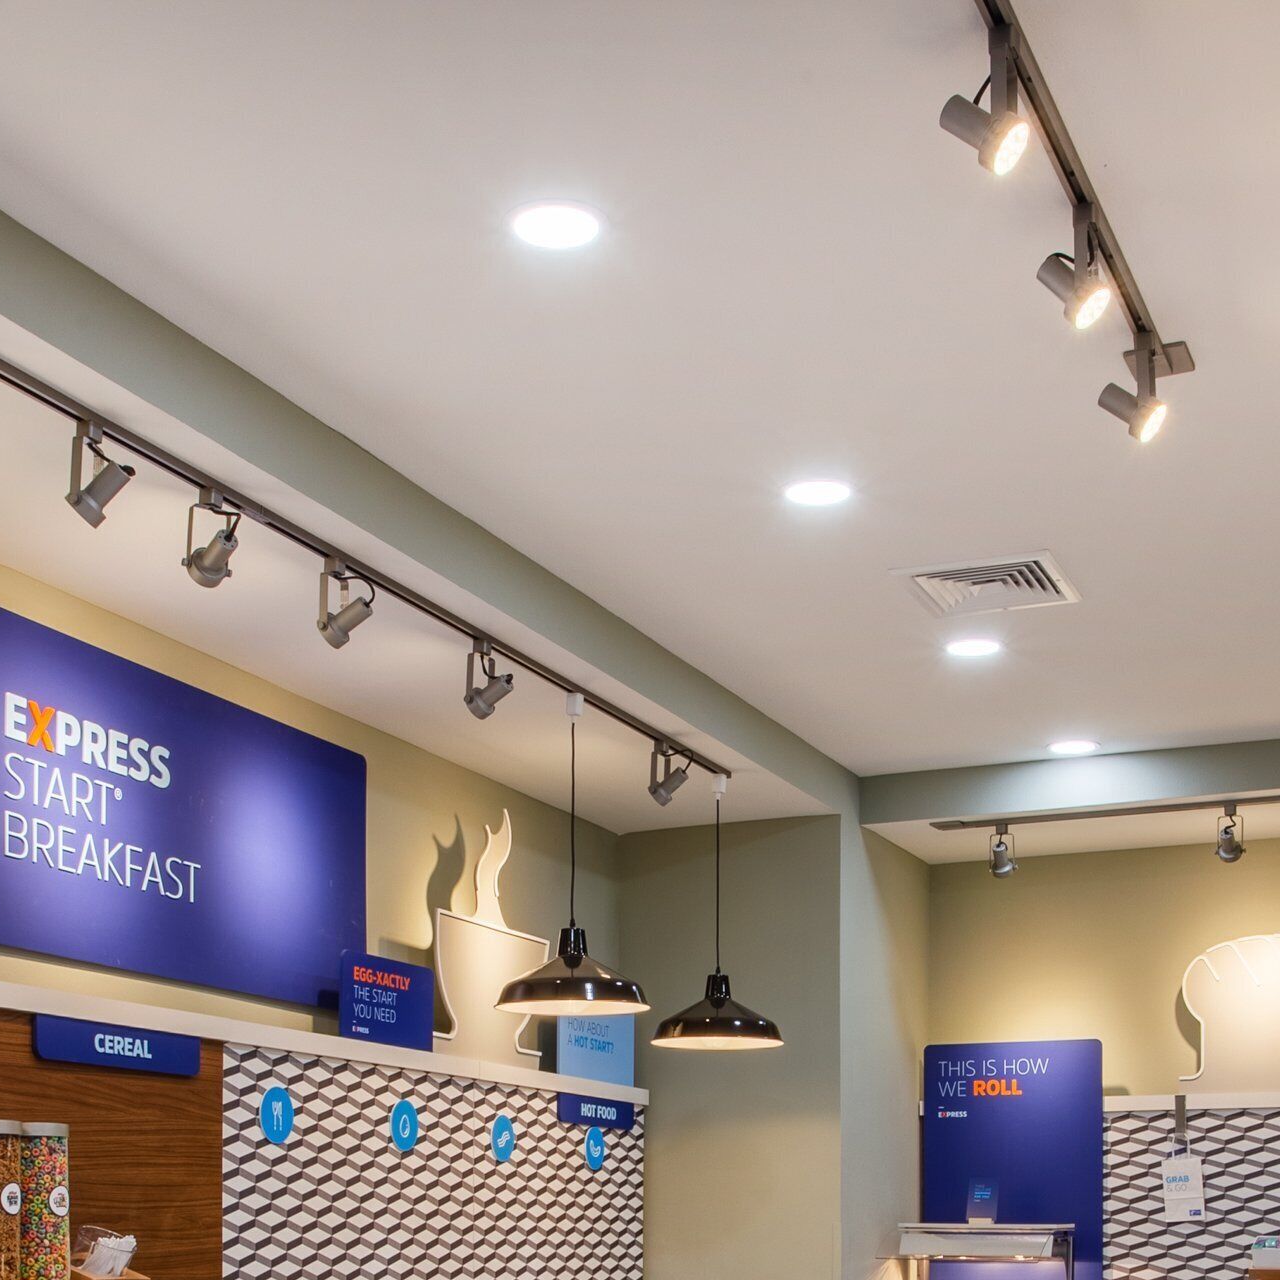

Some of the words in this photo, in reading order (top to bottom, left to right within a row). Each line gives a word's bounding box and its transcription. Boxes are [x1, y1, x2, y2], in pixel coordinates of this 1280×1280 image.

[4, 691, 171, 789] EXPRESS
[3, 809, 202, 904] BREAKFAST
[353, 966, 410, 991] EGG-XACTLY
[353, 985, 370, 1001] THE
[372, 989, 397, 1006] START
[353, 1002, 372, 1019] YOU
[374, 1006, 397, 1023] NEED
[567, 1018, 585, 1032] HOW
[587, 1021, 609, 1037] ABOUT
[94, 1033, 152, 1059] CEREAL
[567, 1033, 573, 1046] A
[574, 1035, 589, 1048] HOT
[590, 1037, 614, 1054] START?
[938, 1060, 976, 1077] THIS
[983, 1059, 996, 1076] IS
[1004, 1058, 1049, 1075] HOW
[938, 1080, 966, 1097] WE
[973, 1078, 1022, 1096] ROLL
[581, 1103, 596, 1118] HOT
[597, 1106, 617, 1121] FOOD
[1166, 1175, 1190, 1183] GRAB
[1175, 1183, 1187, 1192] GO
